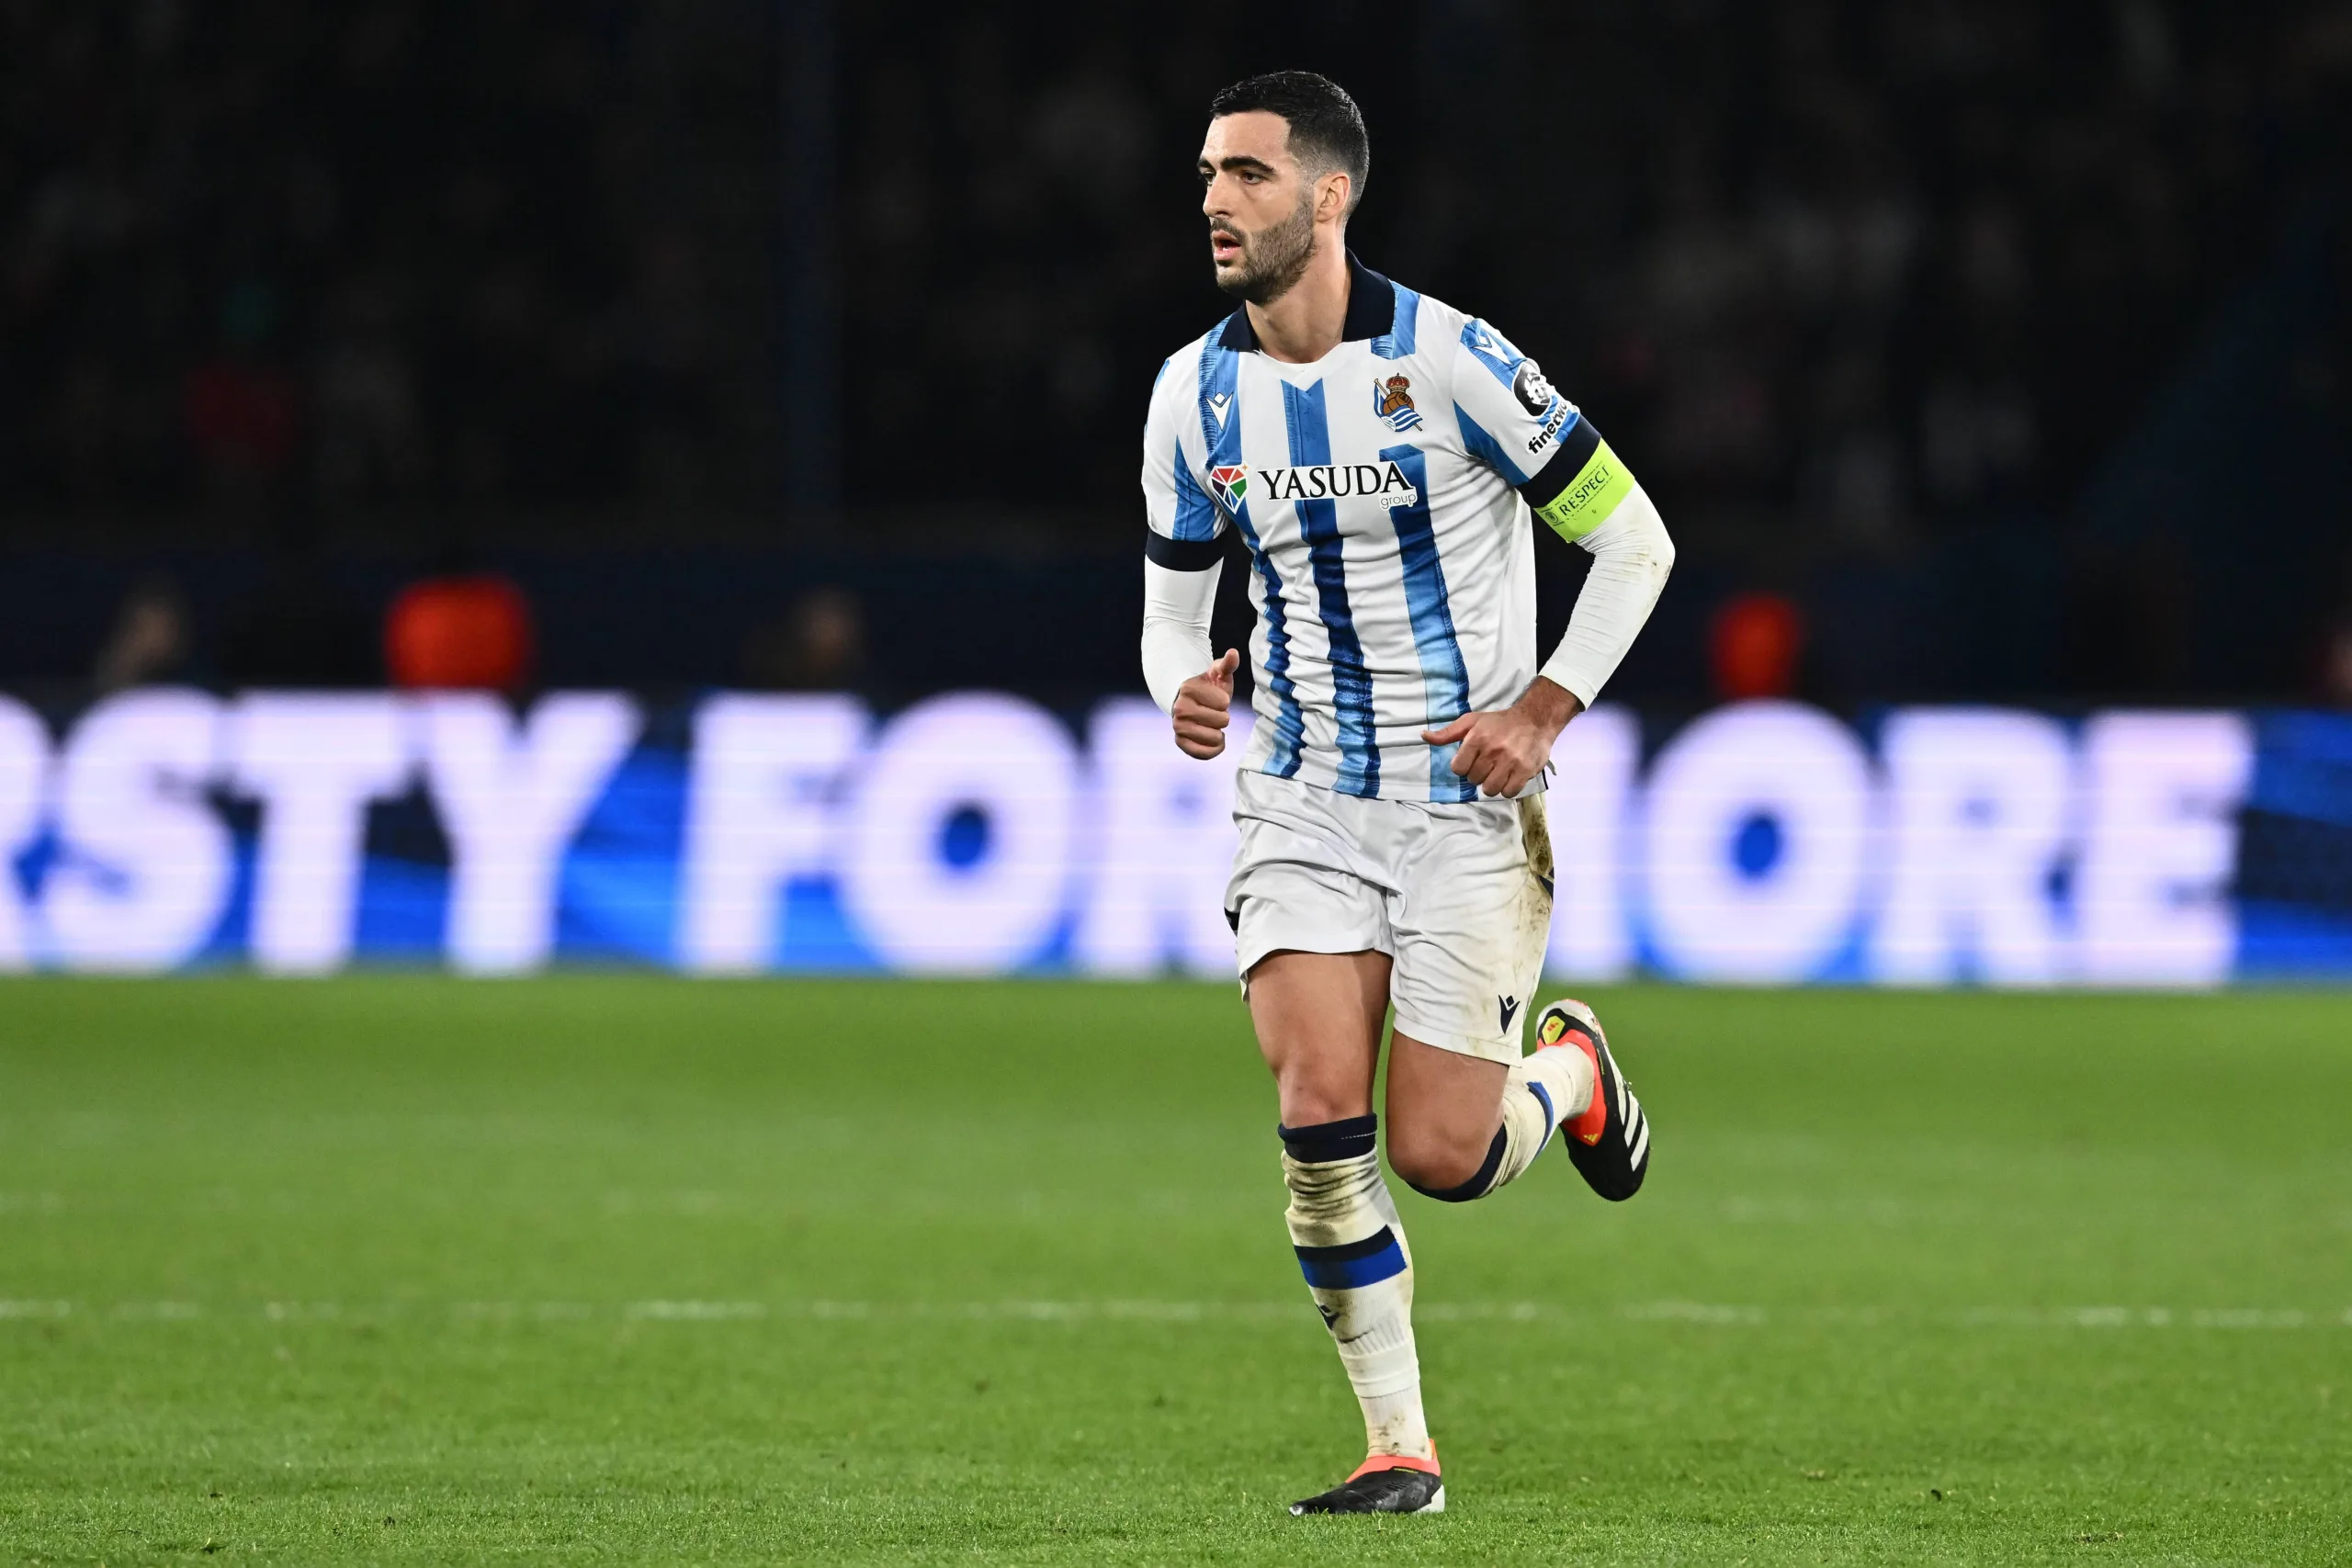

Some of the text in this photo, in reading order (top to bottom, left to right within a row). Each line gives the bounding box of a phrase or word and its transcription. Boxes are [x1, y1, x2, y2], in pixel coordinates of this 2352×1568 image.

[1528, 400, 1567, 454] finetwo
[1258, 461, 1414, 500] YASUDA
[1380, 493, 1417, 510] group
[1558, 465, 1610, 516] RESPECT
[0, 687, 2255, 987] STY FOR ORE
